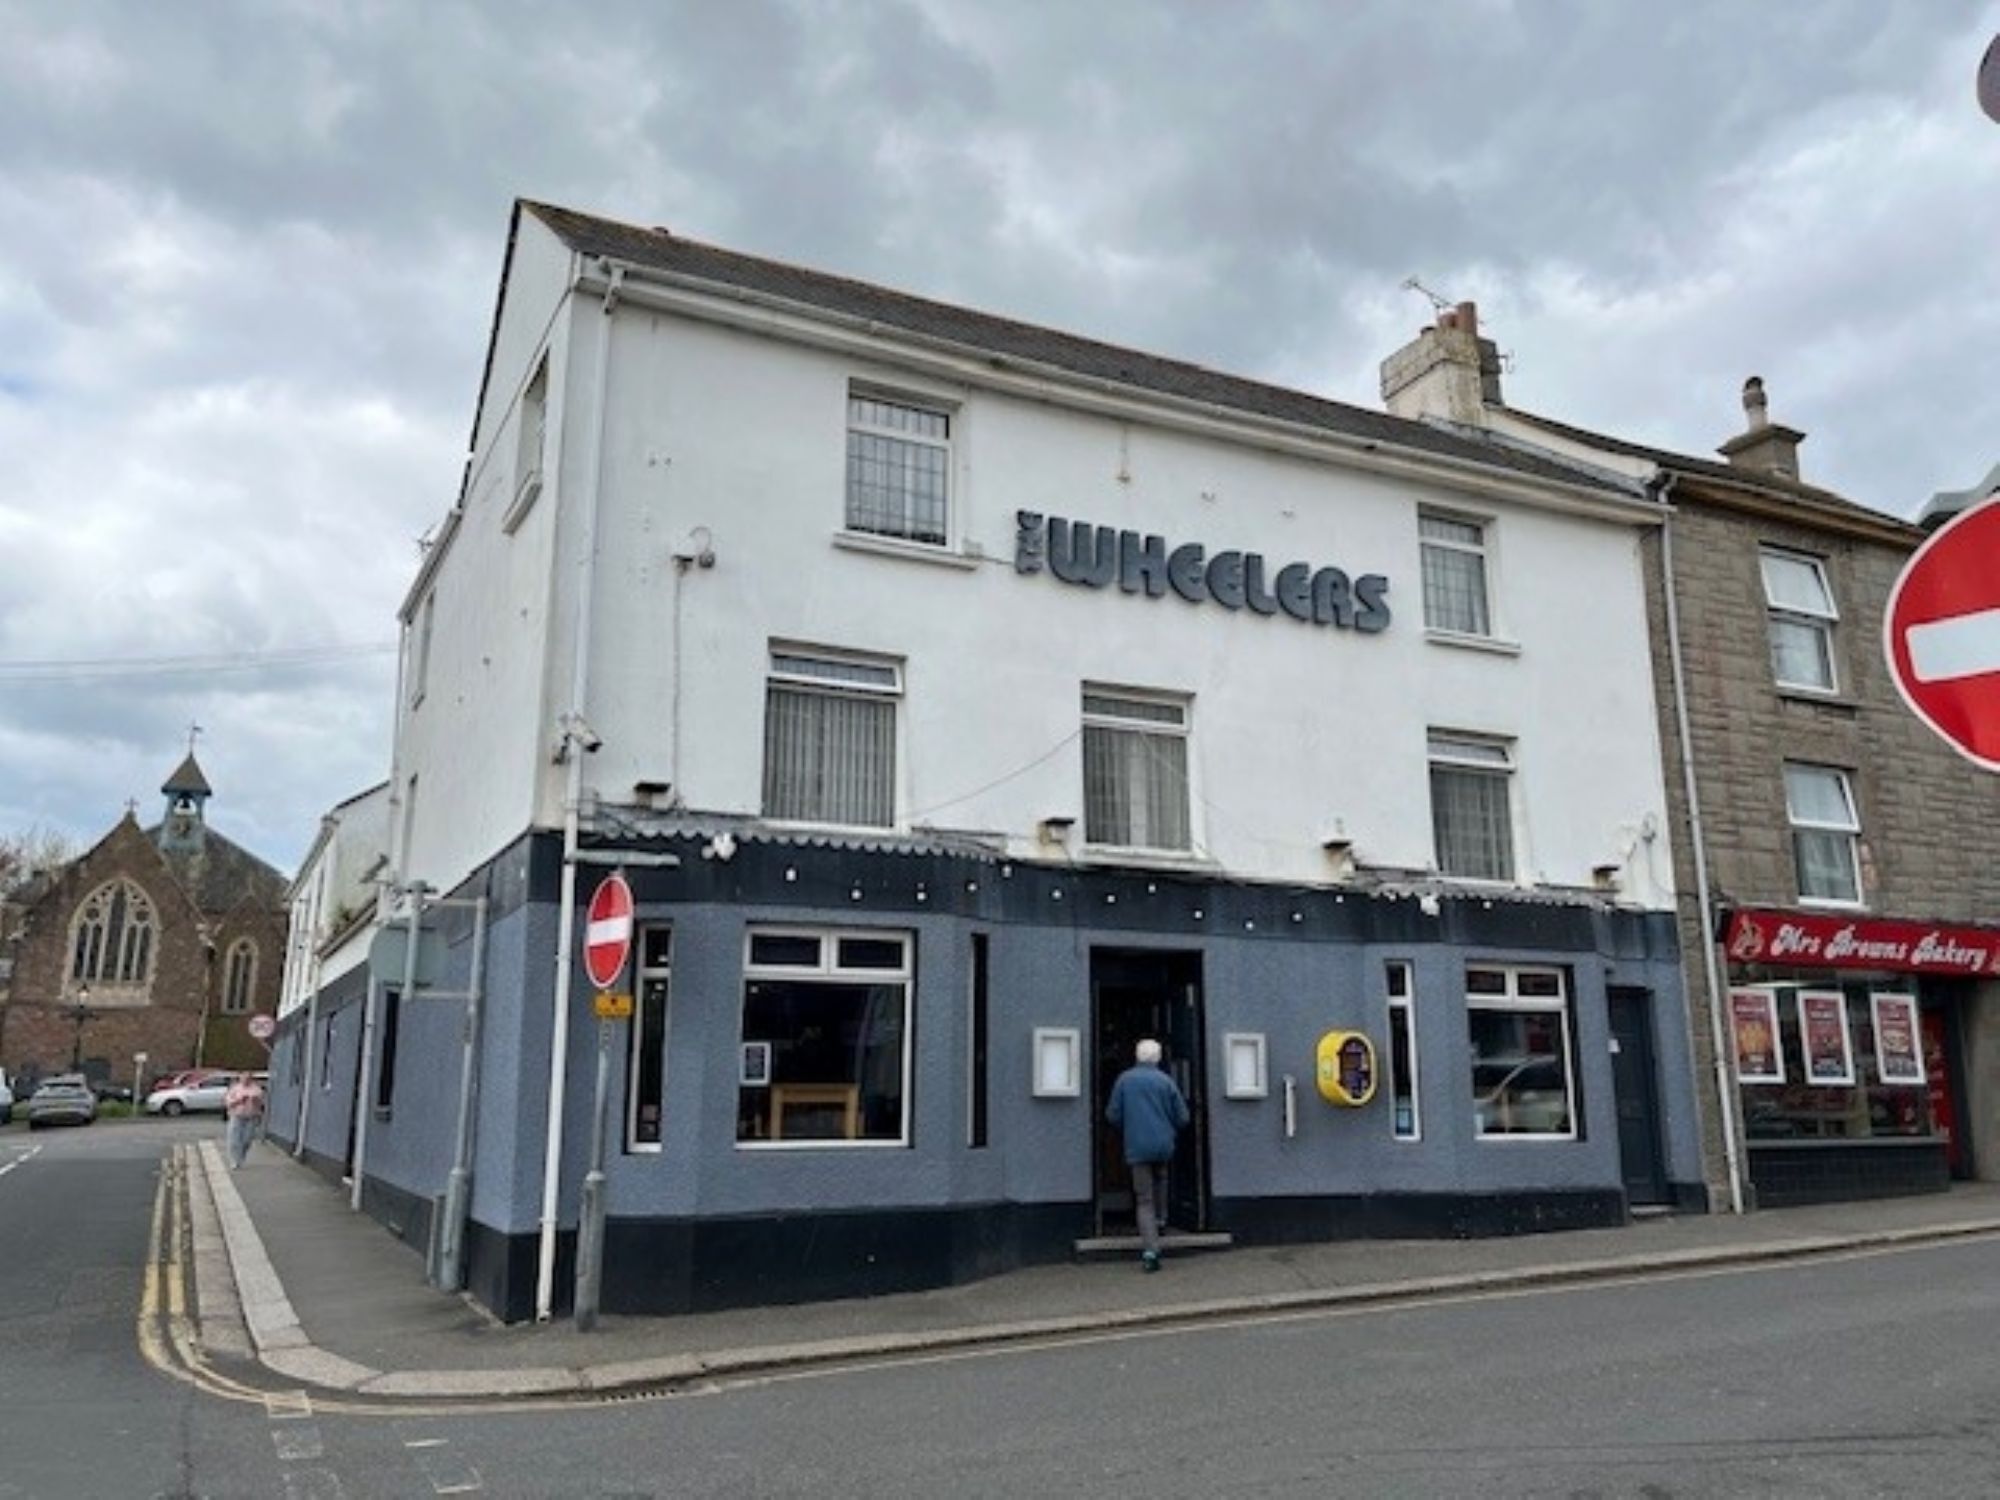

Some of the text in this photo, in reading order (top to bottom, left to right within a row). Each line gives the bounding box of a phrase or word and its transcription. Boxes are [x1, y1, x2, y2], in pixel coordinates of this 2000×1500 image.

[1016, 509, 1044, 575] THE
[1047, 516, 1392, 635] WHEELERS
[1770, 923, 1988, 972] Mrs Browns Bakery
